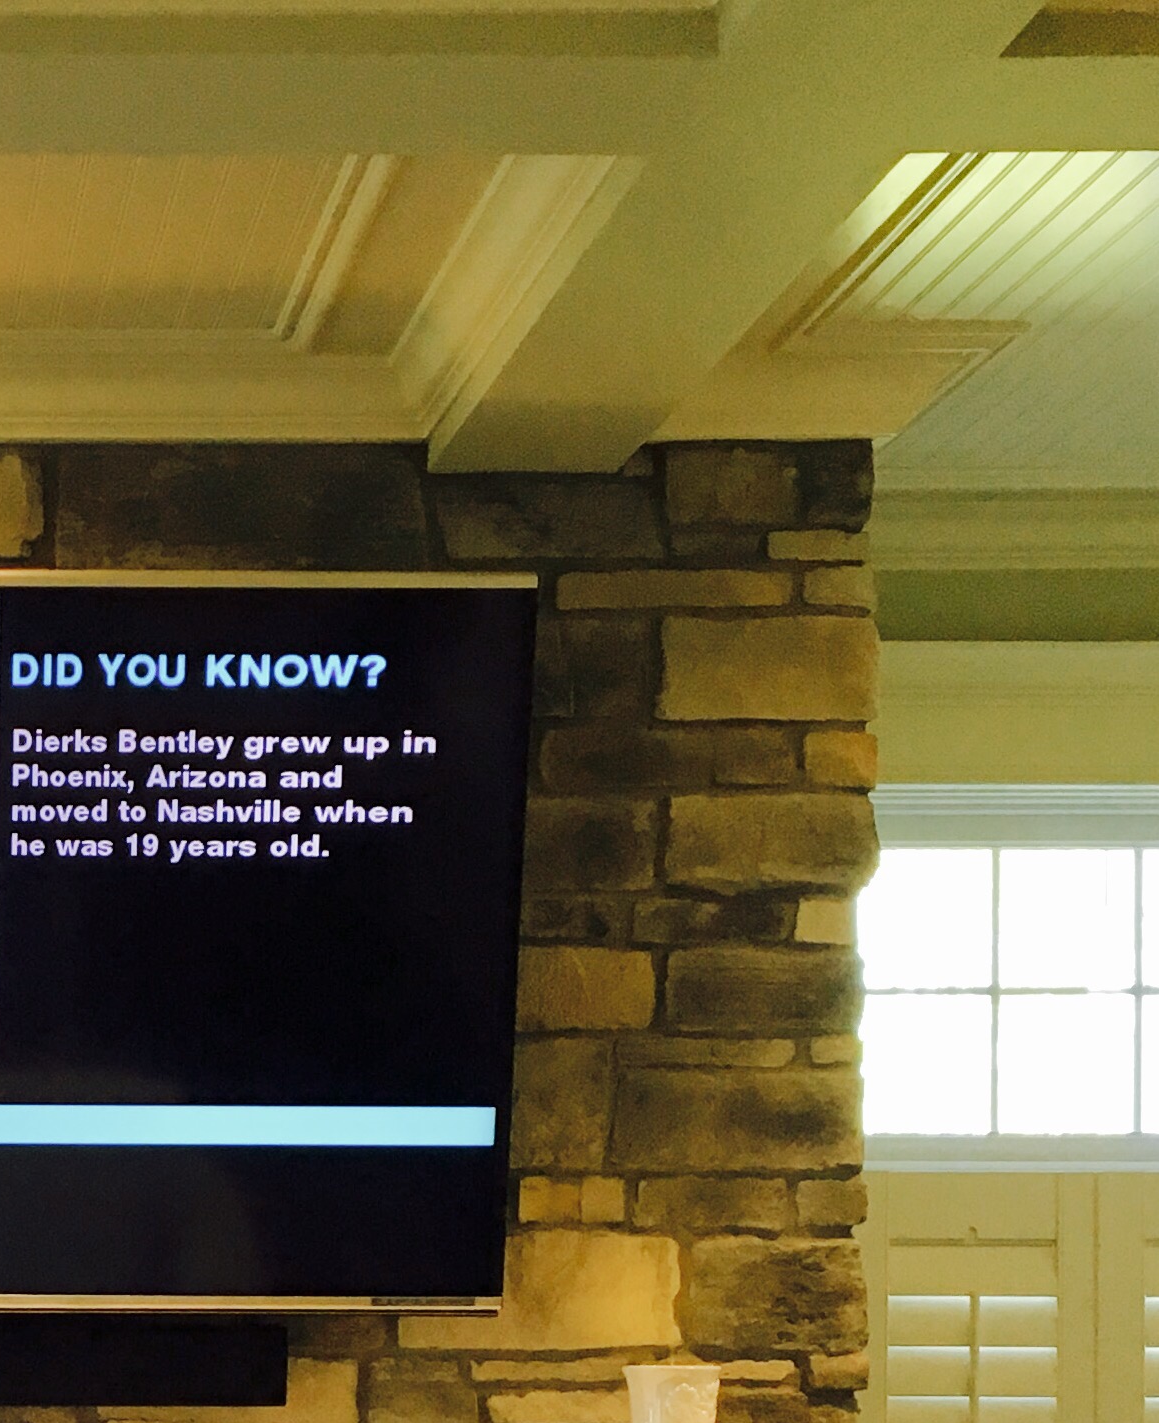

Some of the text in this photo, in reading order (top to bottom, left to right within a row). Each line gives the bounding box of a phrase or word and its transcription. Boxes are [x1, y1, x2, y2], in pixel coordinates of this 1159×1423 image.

[11, 653, 387, 688] DID YOU KNOW?
[12, 728, 437, 761] Dierks Bentley grew up in
[12, 763, 343, 794] Phoenix, Arizona and
[11, 798, 414, 824] moved to Nashville when
[10, 832, 330, 864] he was 19 years old.
